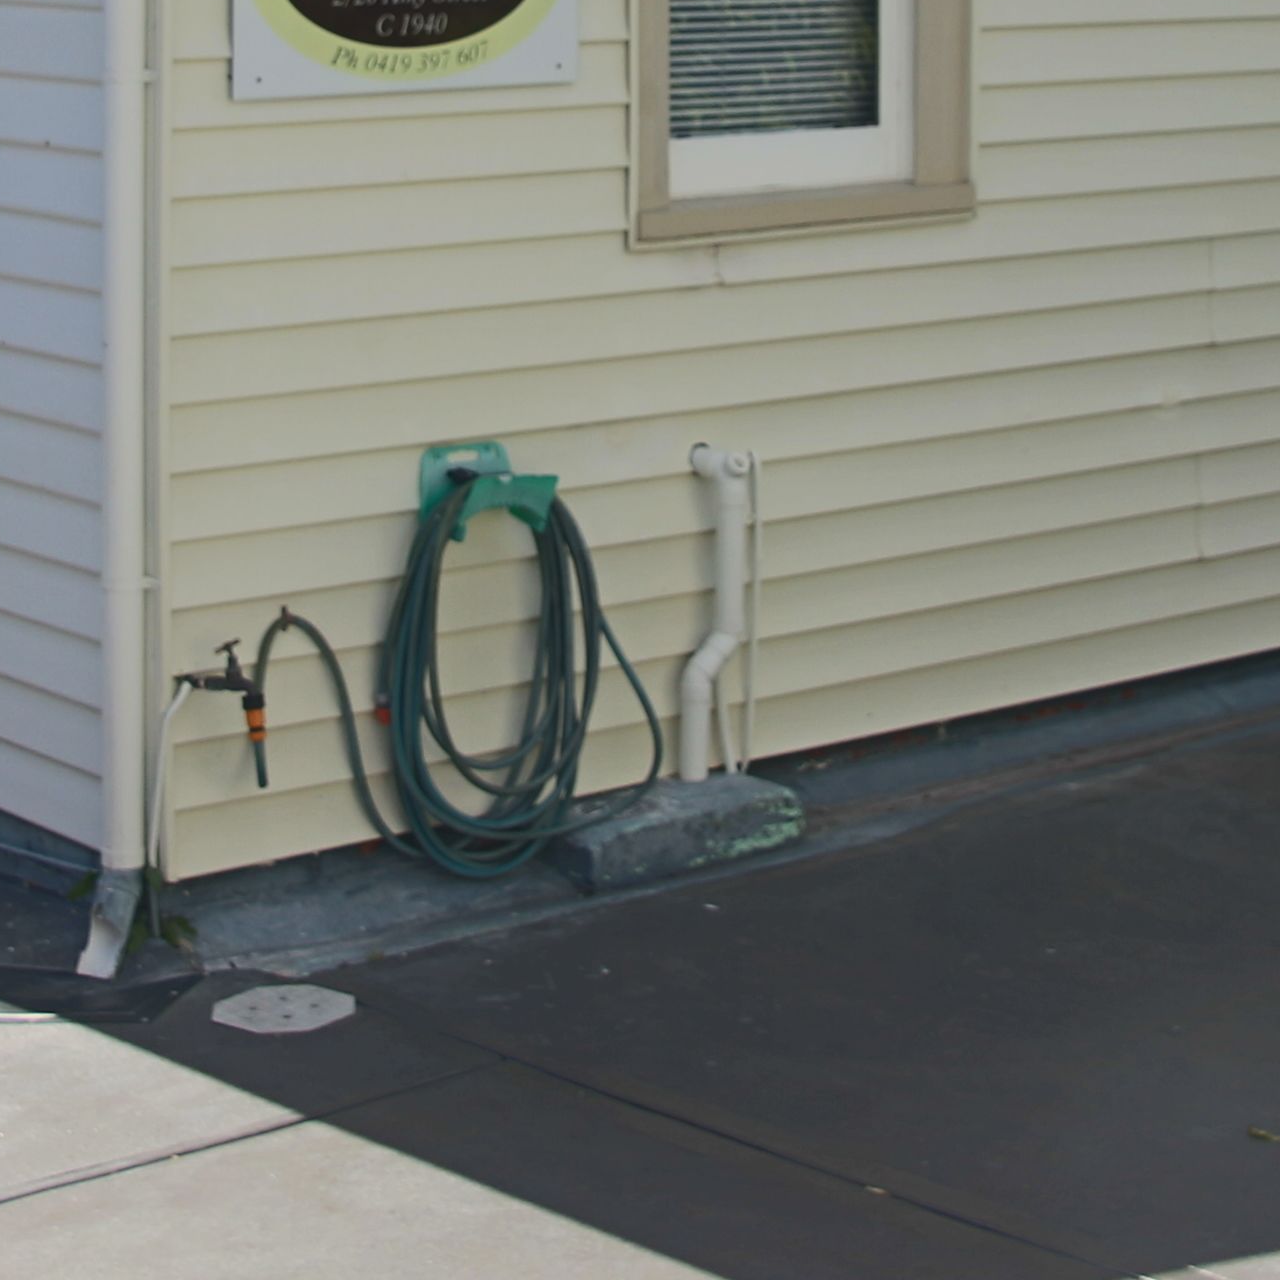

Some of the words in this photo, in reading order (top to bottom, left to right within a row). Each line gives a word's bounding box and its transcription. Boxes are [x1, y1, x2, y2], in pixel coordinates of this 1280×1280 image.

[375, 13, 396, 37] C
[399, 11, 448, 36] 1940
[331, 45, 358, 69] Ph
[365, 52, 413, 73] 0419
[456, 39, 489, 65] 607
